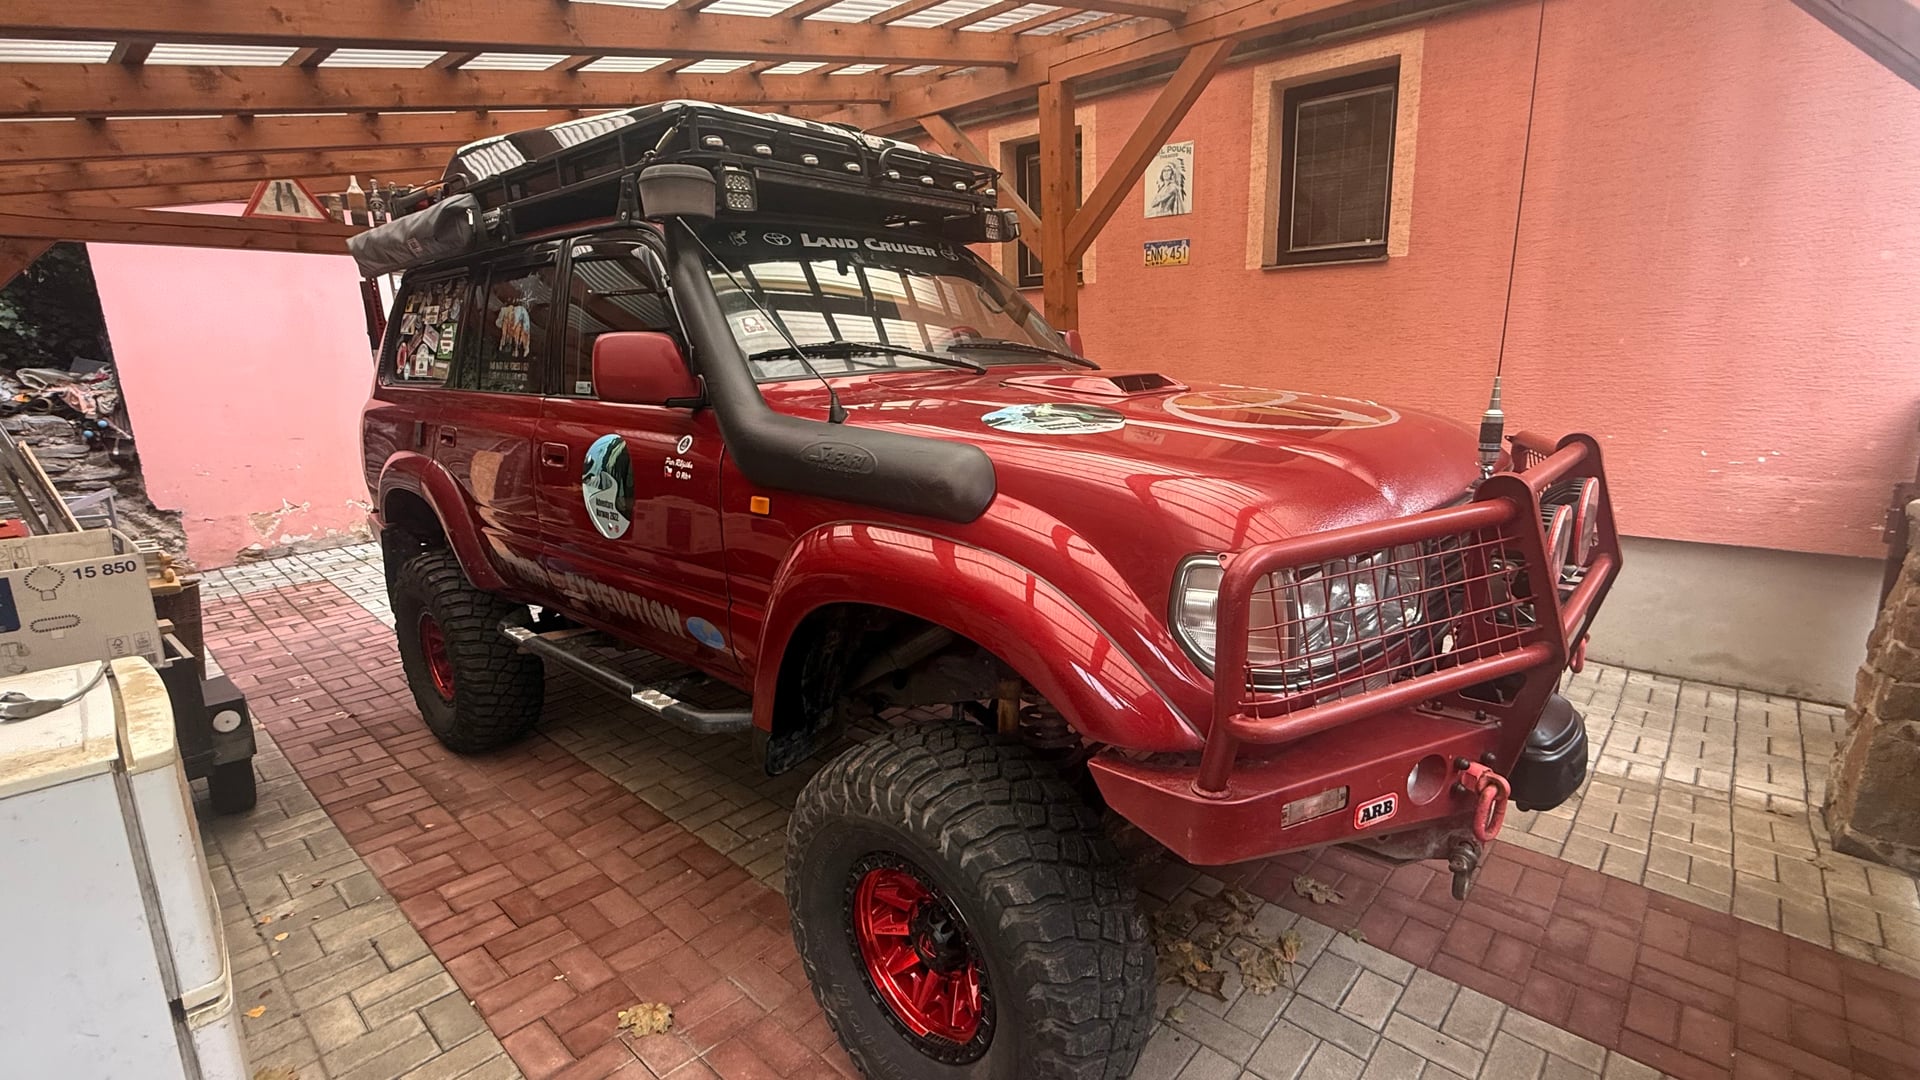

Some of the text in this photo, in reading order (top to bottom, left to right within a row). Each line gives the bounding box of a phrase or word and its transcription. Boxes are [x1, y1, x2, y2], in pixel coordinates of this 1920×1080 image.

[1166, 145, 1192, 155] POUCH
[800, 233, 937, 257] LAND CRUISER
[1170, 246, 1186, 260] 451
[72, 560, 137, 580] 15 850
[1360, 799, 1393, 823] ARB
